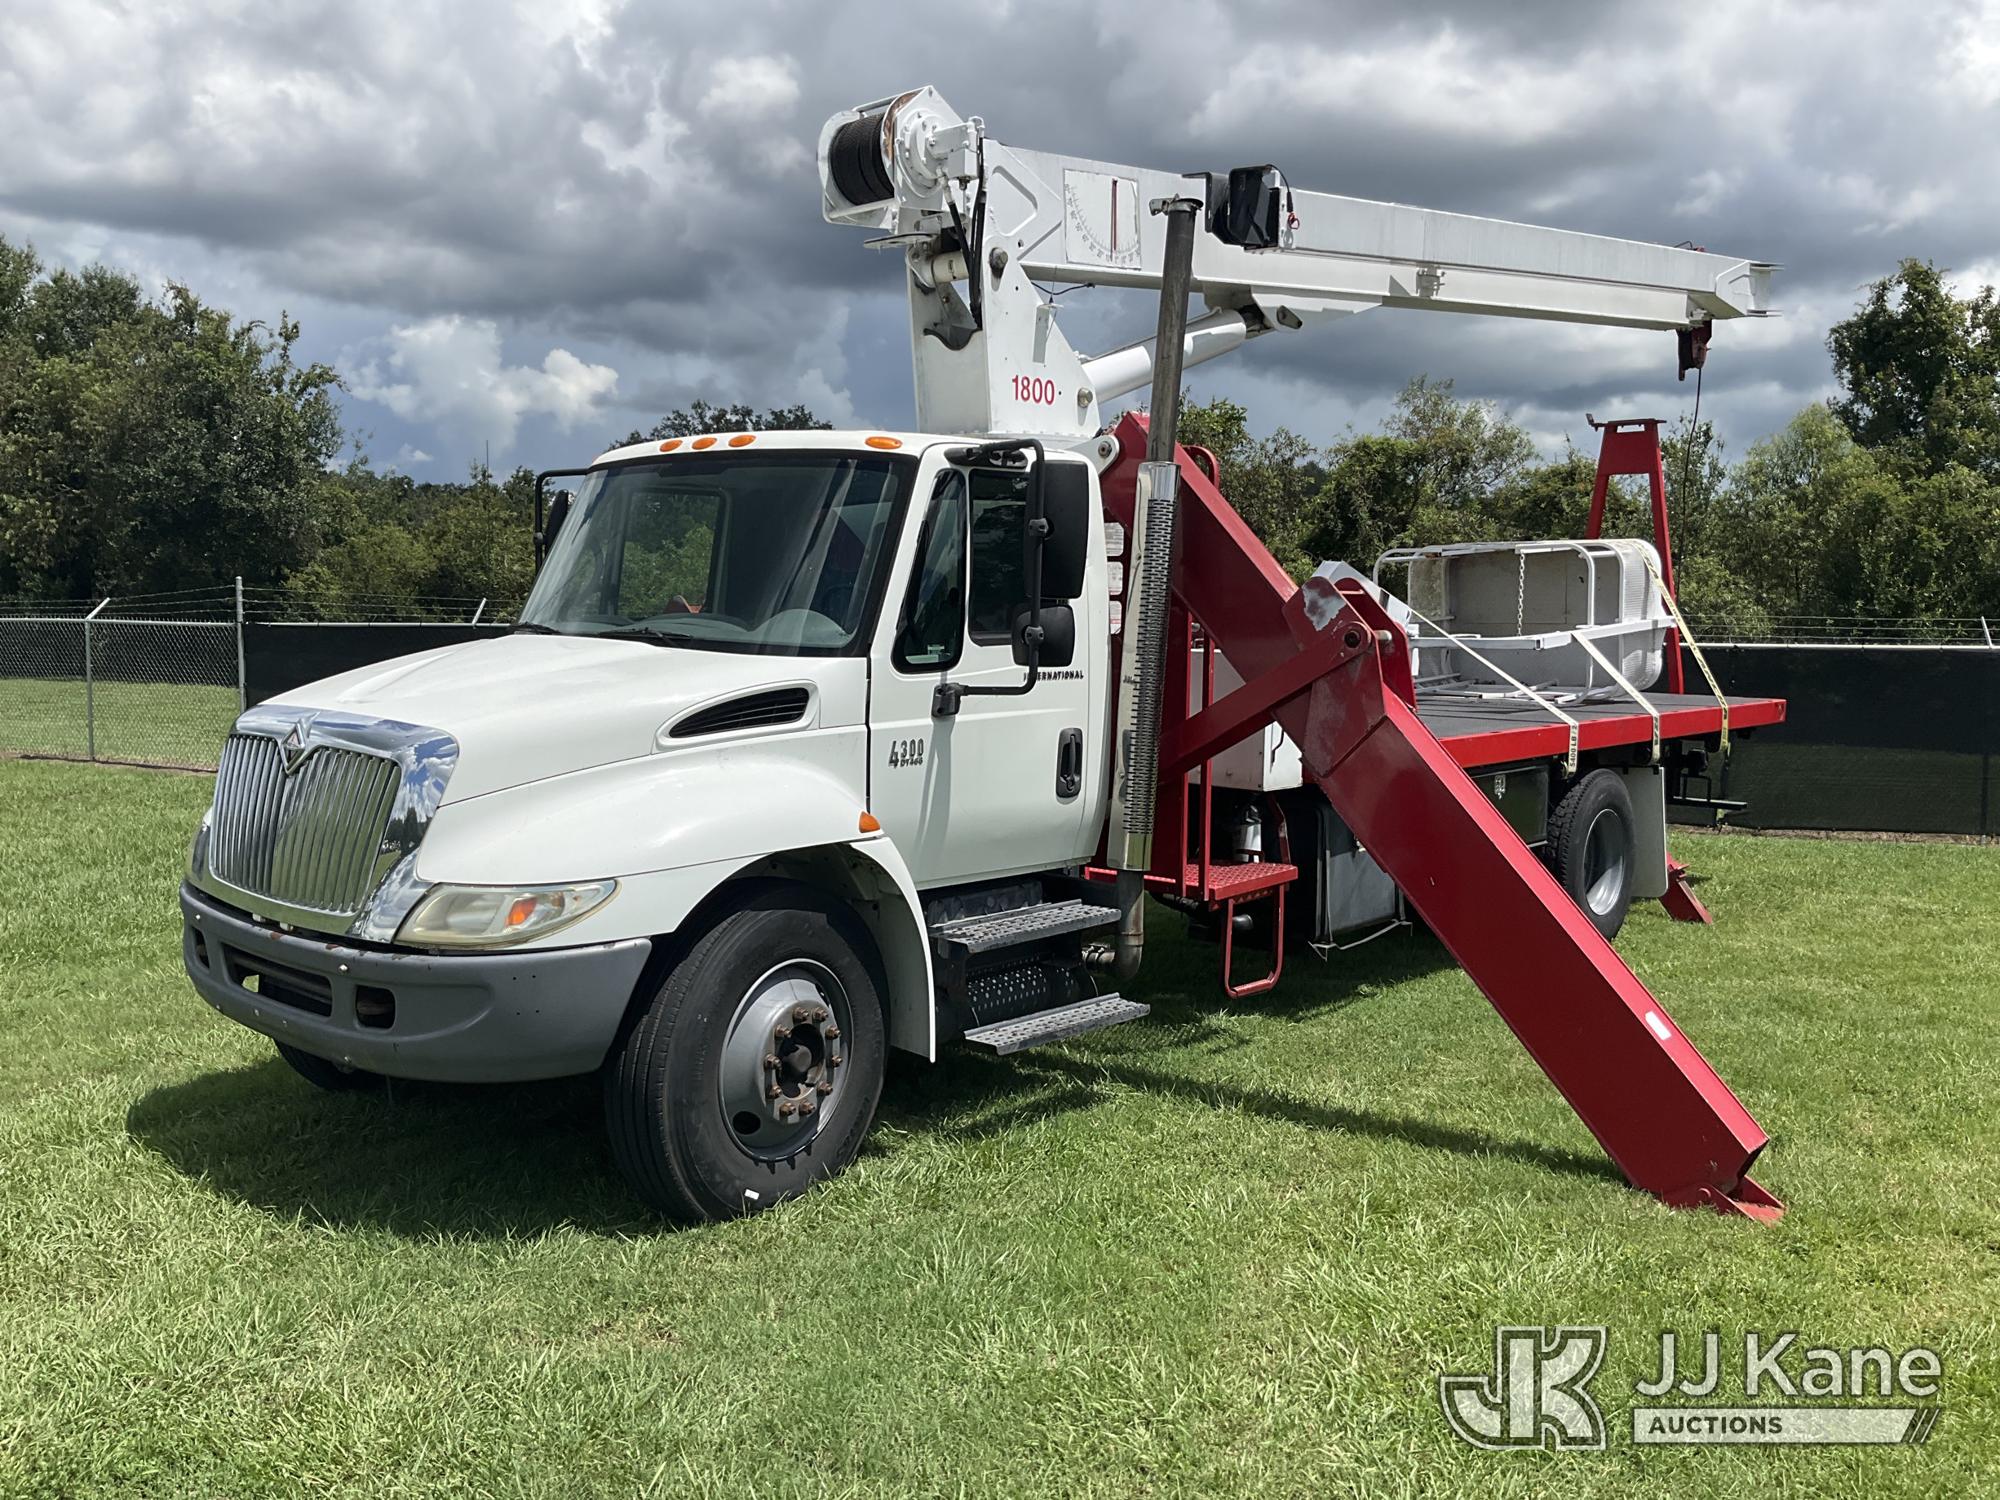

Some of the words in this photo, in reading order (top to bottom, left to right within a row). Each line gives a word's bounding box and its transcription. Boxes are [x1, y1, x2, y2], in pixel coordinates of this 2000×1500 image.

[1012, 374, 1055, 406] 1800
[1023, 670, 1084, 682] IERNATIONAL
[1570, 735, 1577, 747] LB
[888, 738, 924, 769] 4300
[1569, 748, 1577, 768] 5400
